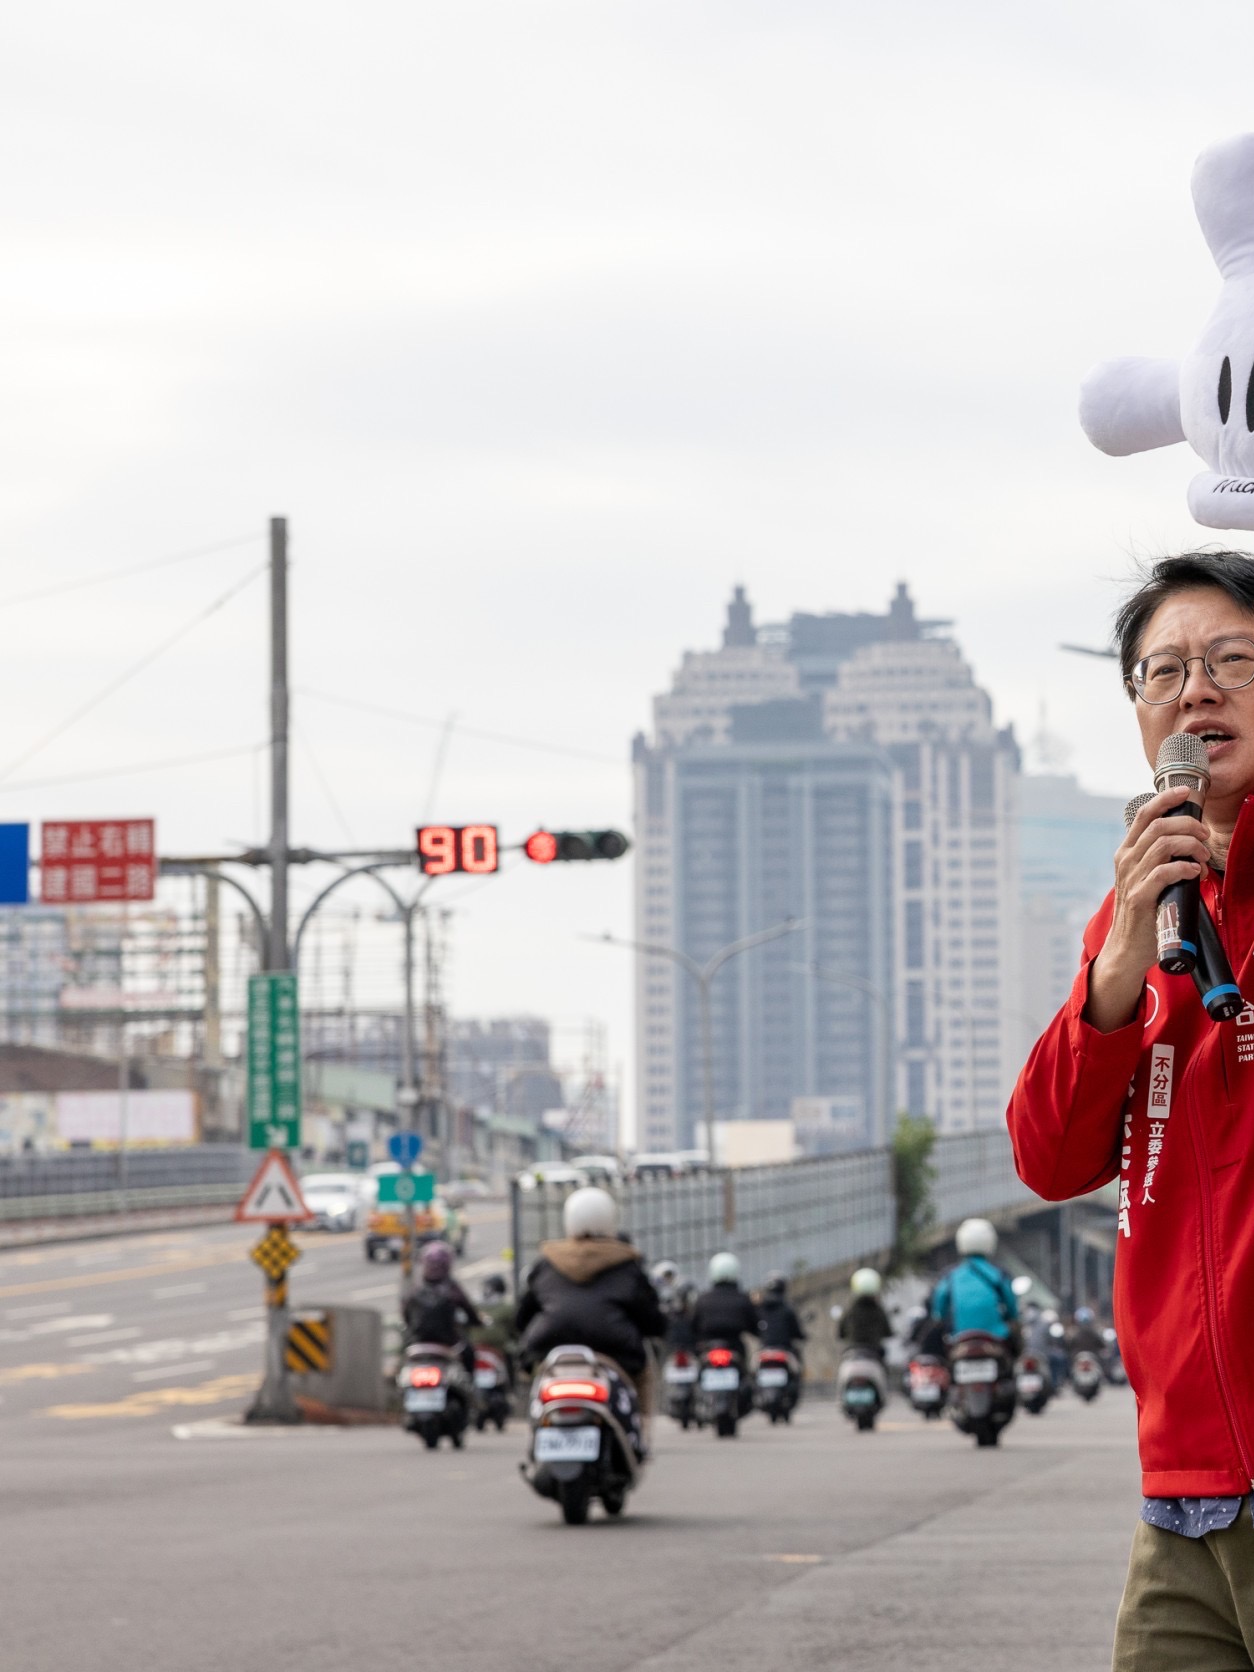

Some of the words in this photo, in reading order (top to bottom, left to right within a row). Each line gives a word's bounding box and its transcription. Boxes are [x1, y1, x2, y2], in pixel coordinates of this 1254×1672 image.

[420, 825, 497, 875] 90
[1151, 1055, 1171, 1108] 不分區
